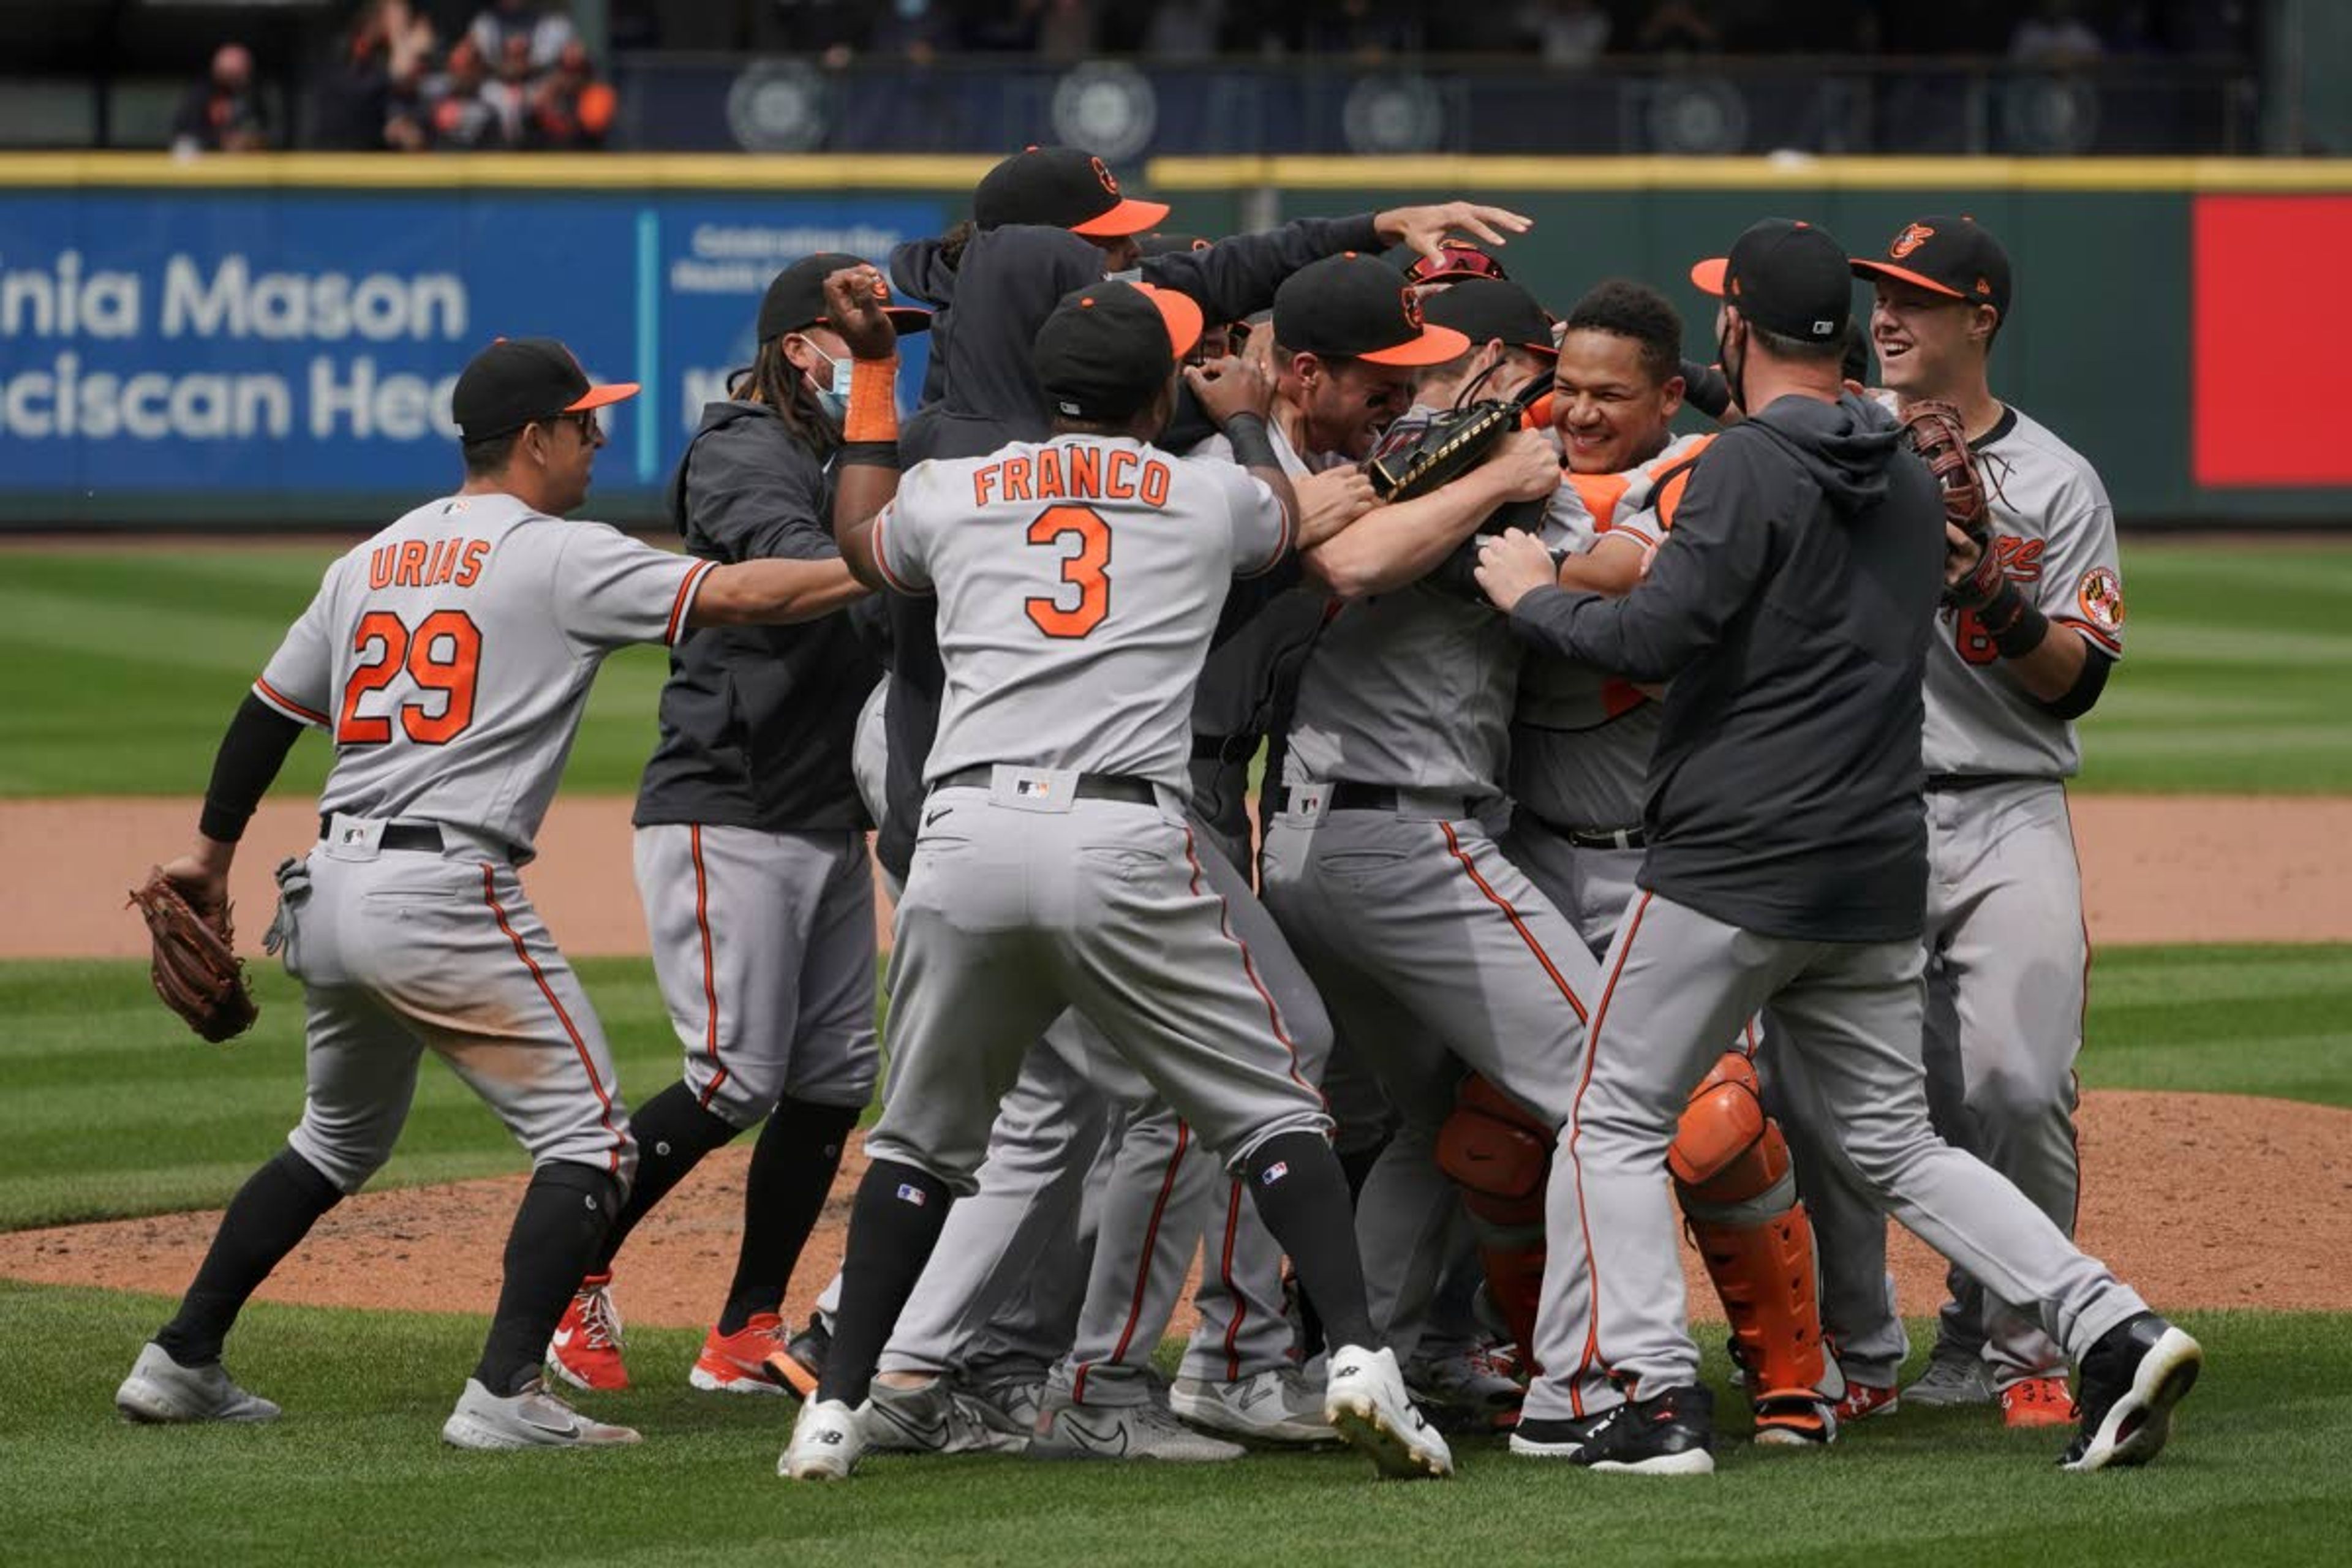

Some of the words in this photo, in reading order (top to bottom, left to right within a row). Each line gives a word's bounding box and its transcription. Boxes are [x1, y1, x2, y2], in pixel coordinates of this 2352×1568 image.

[162, 254, 467, 339] Mason
[973, 446, 1170, 508] FRANCO
[369, 538, 491, 590] URIAS
[1025, 505, 1112, 639] 3
[337, 609, 483, 745] 29
